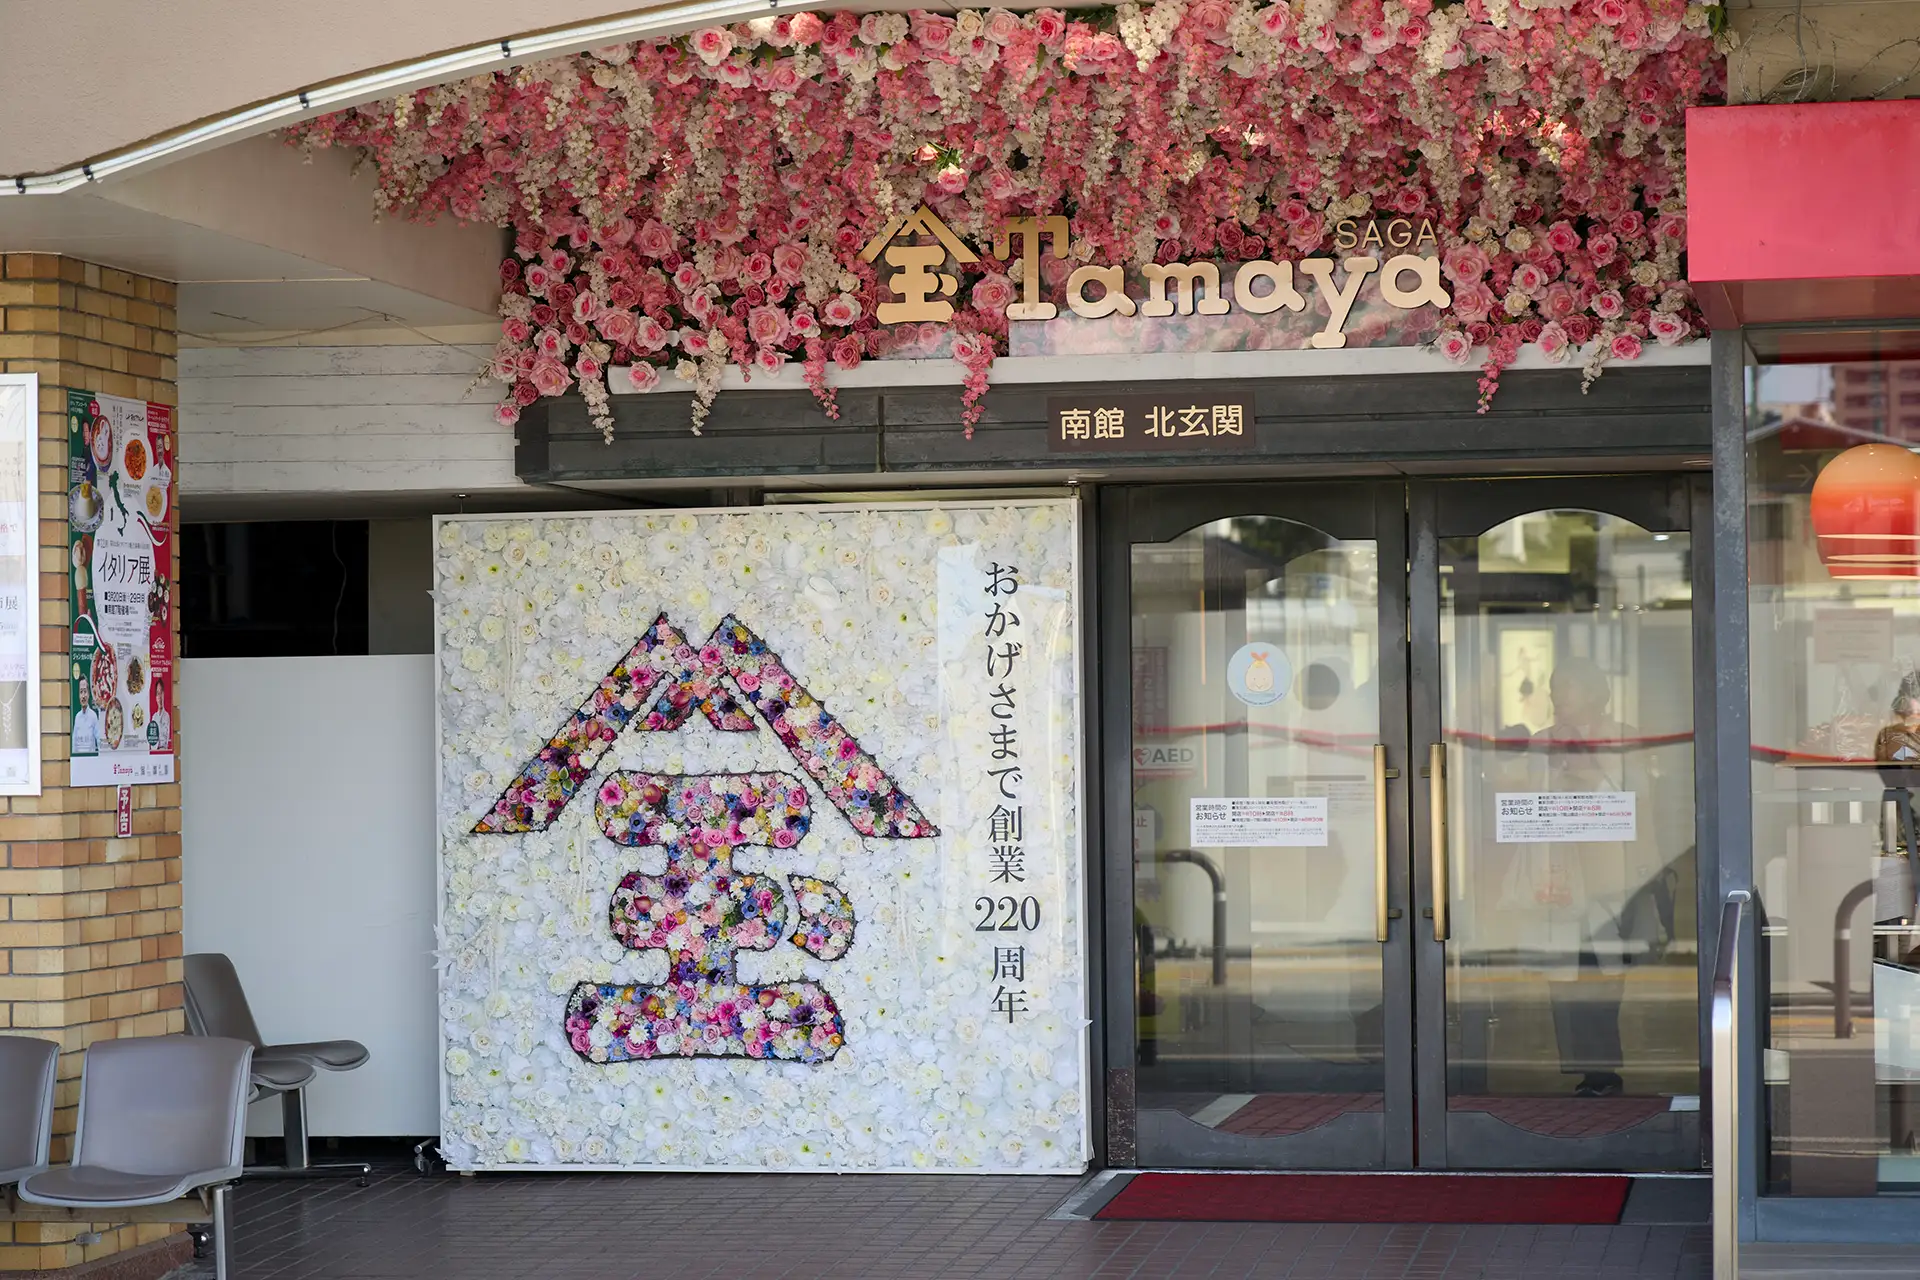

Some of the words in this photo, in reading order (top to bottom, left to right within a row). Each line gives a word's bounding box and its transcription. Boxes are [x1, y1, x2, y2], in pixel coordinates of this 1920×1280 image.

[1335, 217, 1439, 250] SAGA
[993, 214, 1452, 349] Tamaya
[1059, 407, 1126, 441] 南館
[1143, 404, 1244, 438] 北玄関
[98, 551, 151, 585] イタリア展
[1152, 748, 1194, 763] AED
[974, 560, 1042, 1025] おかげさまで創業220周年
[1500, 799, 1534, 807] 営業時間の
[1195, 804, 1228, 812] 営業時間の
[1195, 812, 1227, 821] お知らせ
[1501, 807, 1533, 816] お知らせ
